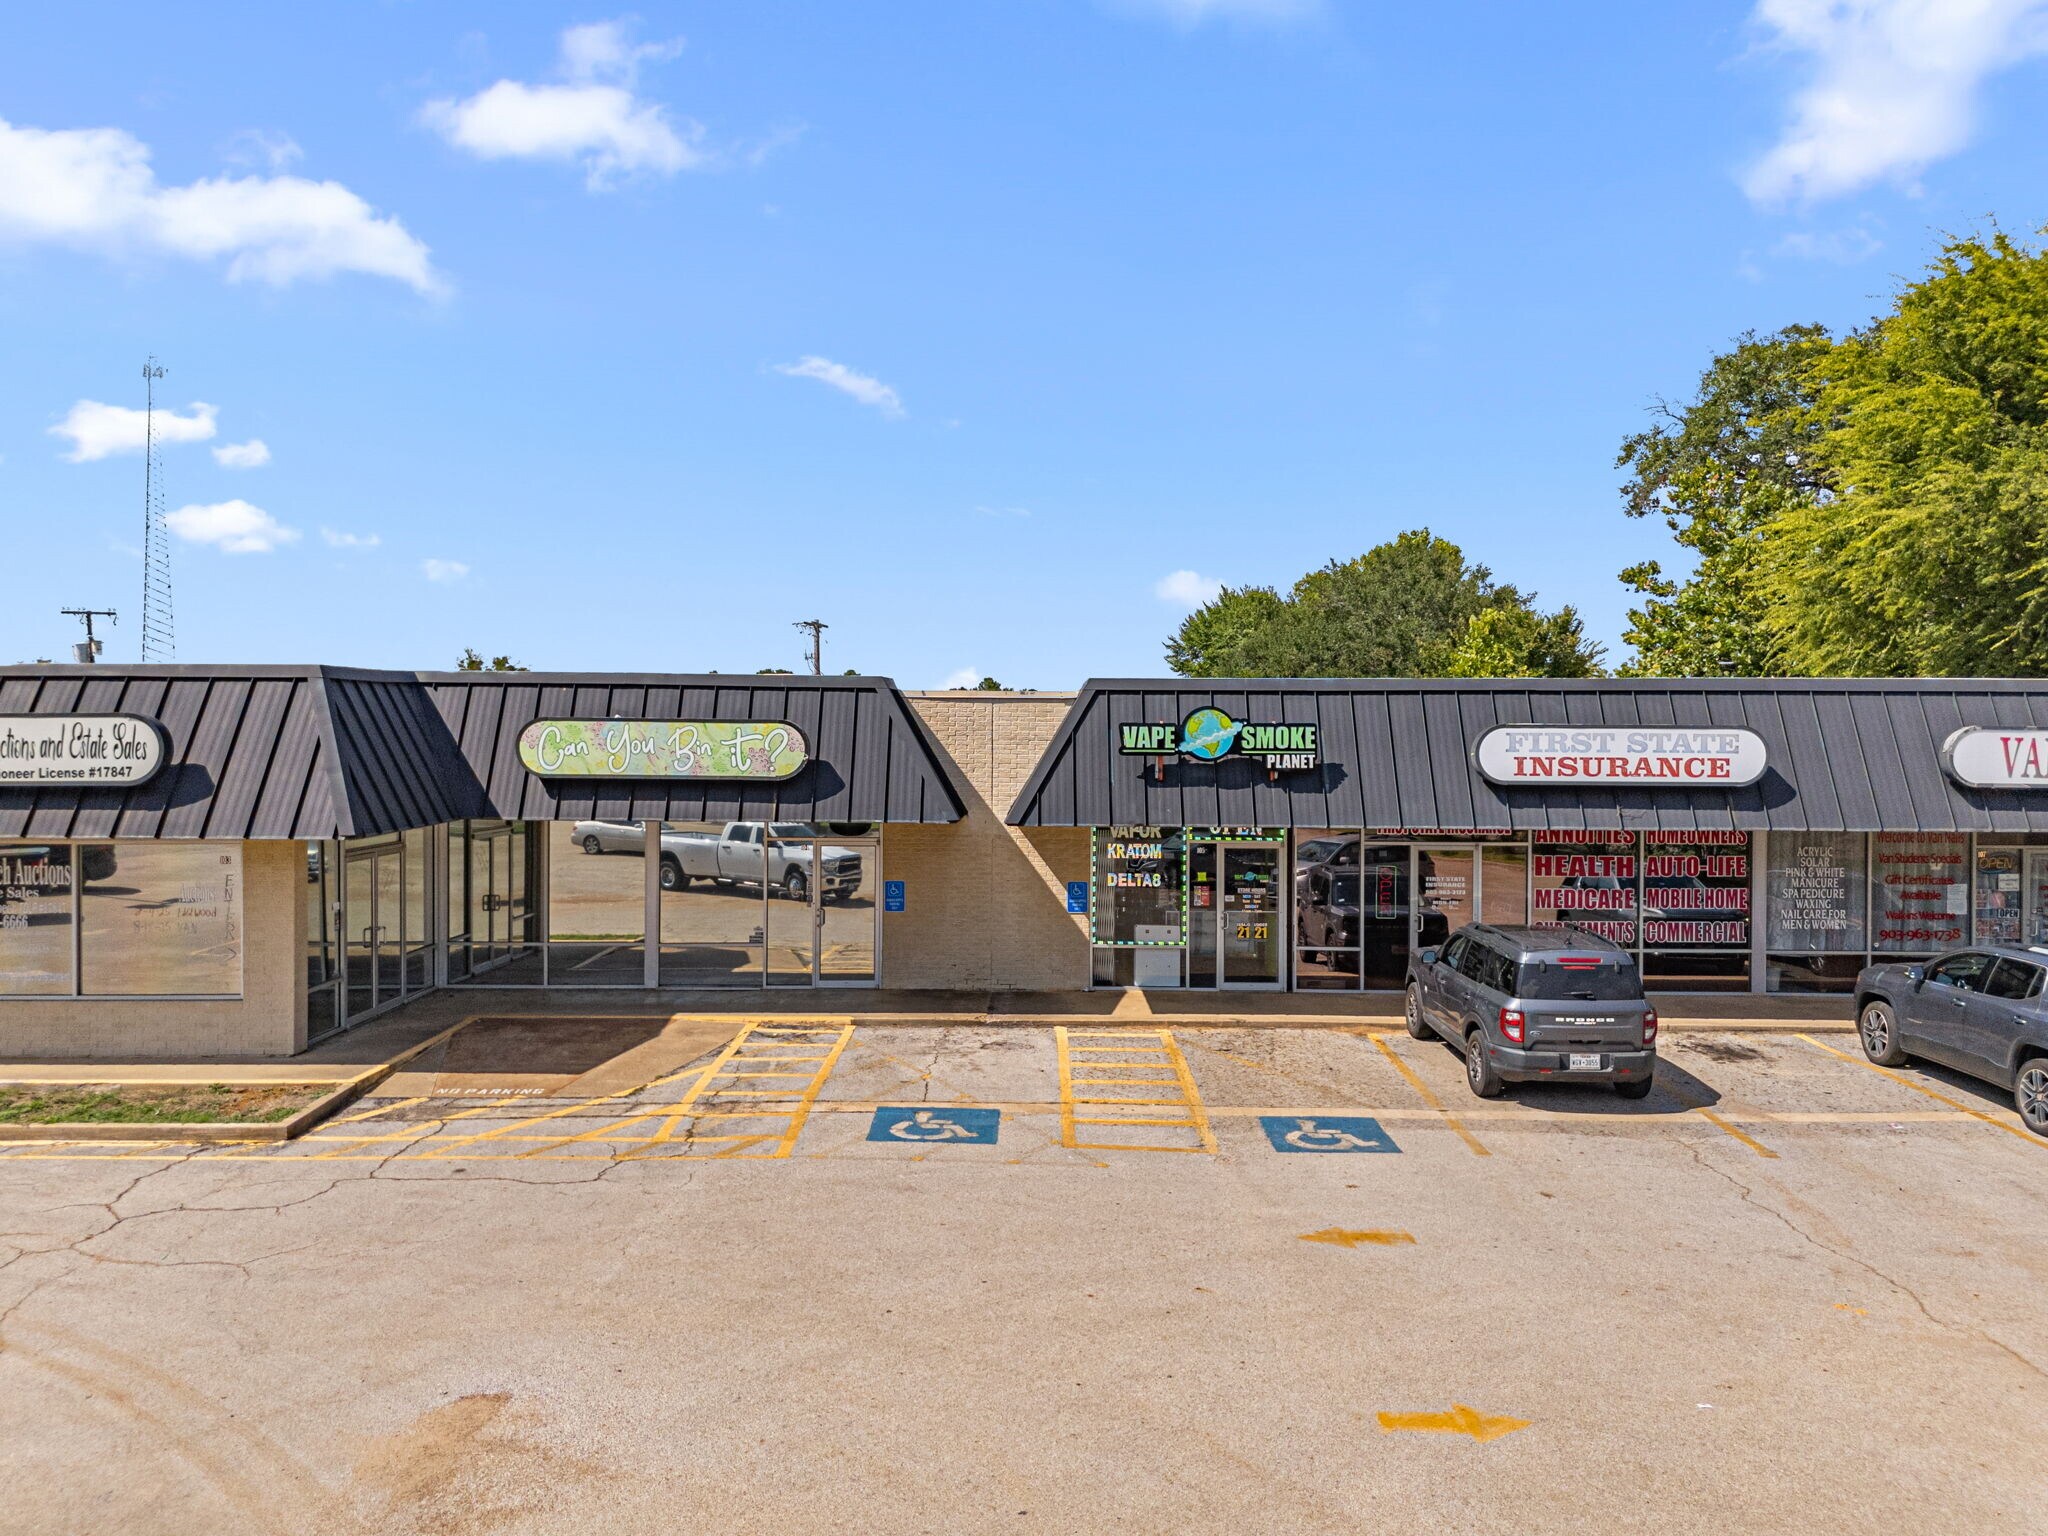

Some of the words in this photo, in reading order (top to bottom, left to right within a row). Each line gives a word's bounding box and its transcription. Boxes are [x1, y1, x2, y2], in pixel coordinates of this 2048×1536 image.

[40, 723, 65, 760] and
[70, 722, 107, 759] Estate
[113, 722, 147, 760] Sales
[1123, 726, 1175, 748] VAPE
[1241, 726, 1315, 749] SMOKE
[1505, 732, 1616, 753] FIRST
[1627, 732, 1740, 754] STATE
[537, 725, 589, 770] Can
[606, 723, 655, 773] You
[667, 725, 712, 772] Bin
[1267, 754, 1315, 769] PLANET
[2000, 737, 2048, 778] VA
[39, 767, 85, 778] License
[89, 766, 132, 778] #17847
[1514, 756, 1730, 778] INSURANCE
[1107, 843, 1163, 859] KRATOM
[1797, 847, 1834, 856] ACRYLIC
[1534, 856, 1635, 878] HEALTH
[1646, 855, 1747, 878] AUTO-LIFE
[1800, 857, 1830, 867] SOLAR
[1979, 858, 2014, 869] OPEN
[14, 857, 72, 887] Auctions
[1785, 868, 1806, 878] PINK
[1808, 868, 1814, 877] &
[1816, 868, 1845, 878] WHITE
[1107, 873, 1161, 887] DELTA8
[1791, 878, 1839, 888] MANICURE
[6, 886, 40, 899] Sales
[1535, 888, 1634, 909] MEDICARE
[1646, 888, 1701, 909] MOBILE
[1704, 888, 1748, 909] HOME
[1782, 889, 1799, 899] SPA
[1800, 889, 1845, 899] PEDICURE
[1795, 899, 1832, 909] WAXING
[1781, 909, 1802, 919] NAIL
[1803, 909, 1827, 919] CARE
[1828, 909, 1846, 919] FOR
[1999, 908, 2019, 918] OPEN
[1238, 926, 1250, 938] 21
[1645, 921, 1746, 943] COMMERCIAL
[1782, 920, 1803, 929] MEN
[1804, 920, 1811, 929] &
[1812, 920, 1847, 930] WOMEN
[1254, 926, 1268, 939] 21
